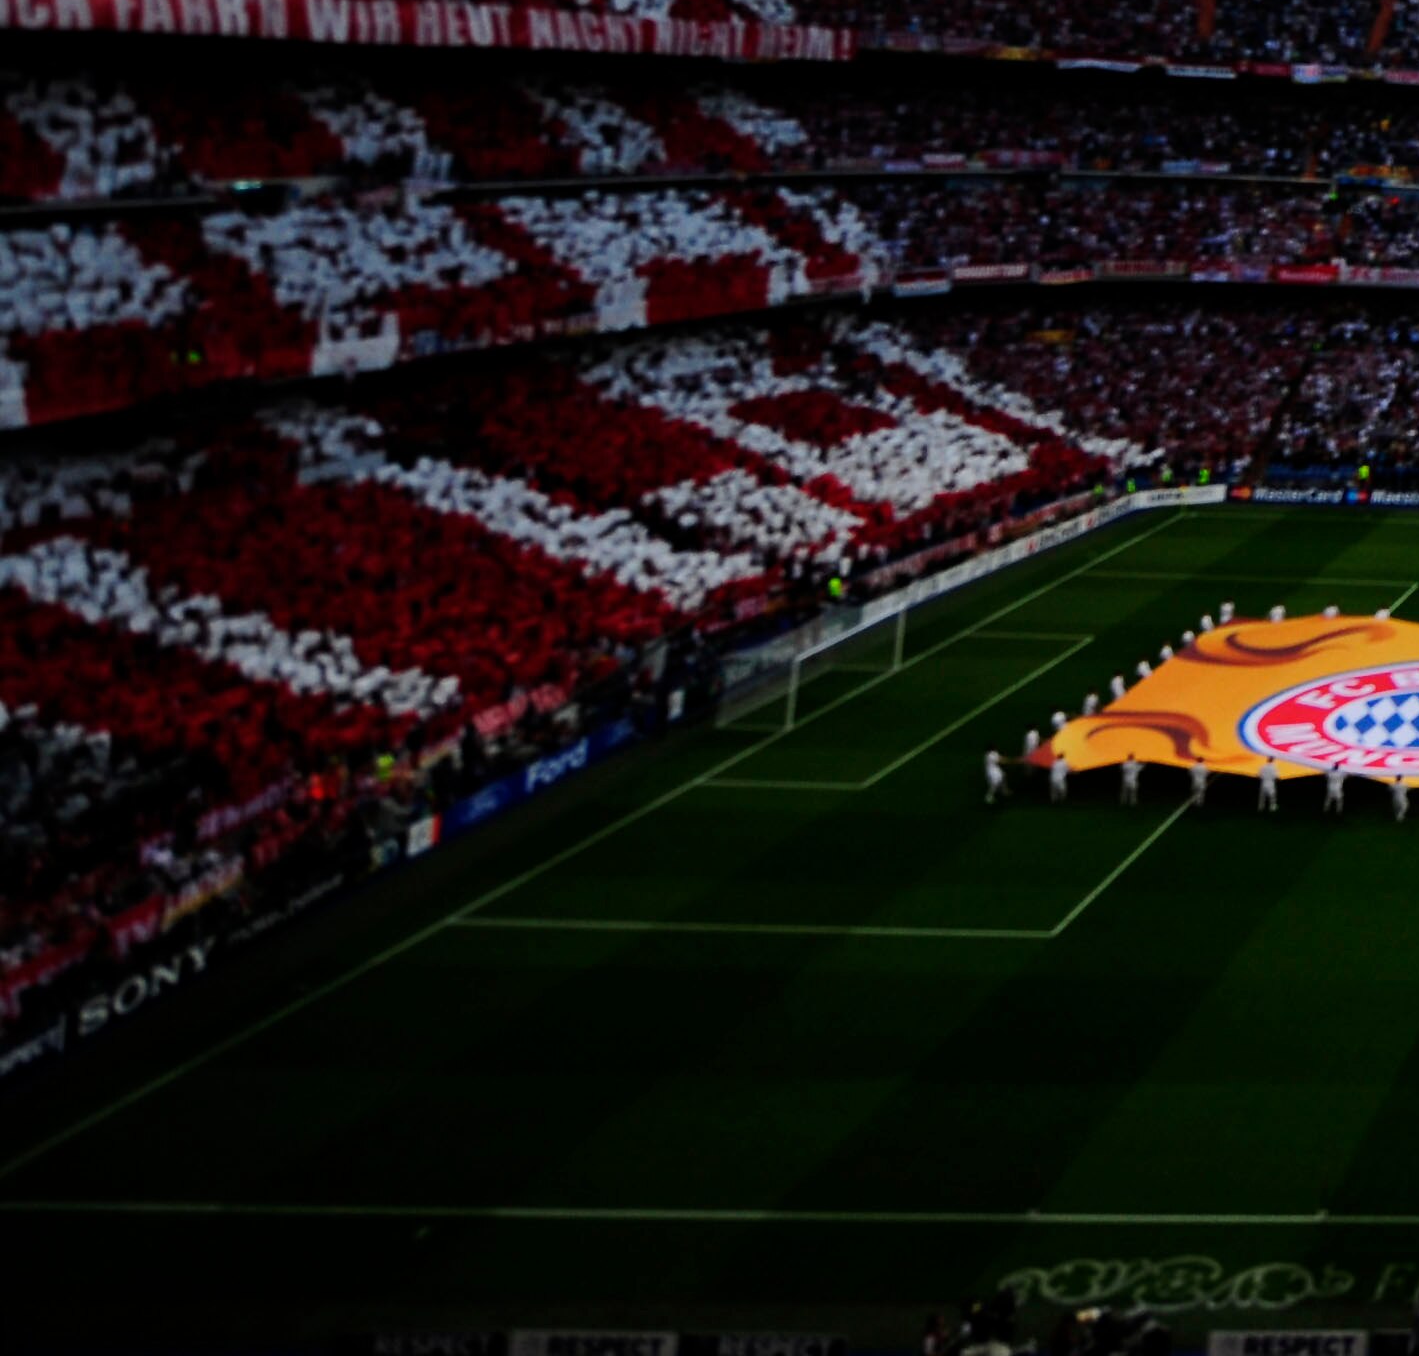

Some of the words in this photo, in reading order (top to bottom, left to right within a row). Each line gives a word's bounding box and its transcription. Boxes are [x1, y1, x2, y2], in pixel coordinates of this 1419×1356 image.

[1295, 678, 1376, 710] FC
[525, 734, 590, 794] Ford
[77, 934, 217, 1038] SONY
